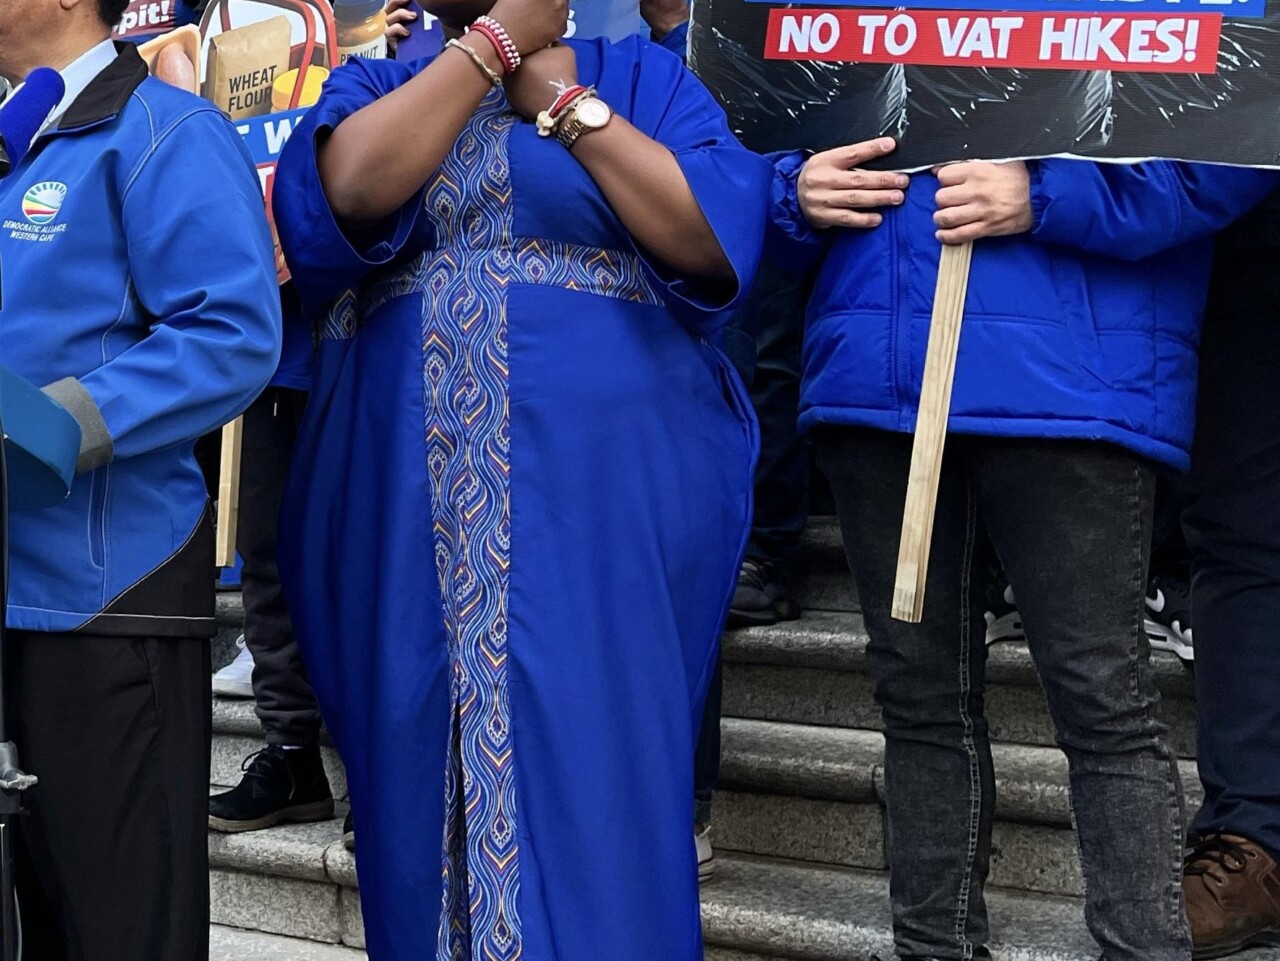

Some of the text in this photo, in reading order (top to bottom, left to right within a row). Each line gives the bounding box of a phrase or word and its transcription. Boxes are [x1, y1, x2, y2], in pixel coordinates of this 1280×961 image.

[779, 13, 1201, 63] NO TO VAT HIKES!
[229, 65, 277, 94] WHEAT
[3, 220, 67, 233] DEMOCRATIC ALLIANCE
[10, 230, 39, 241] WESTERN
